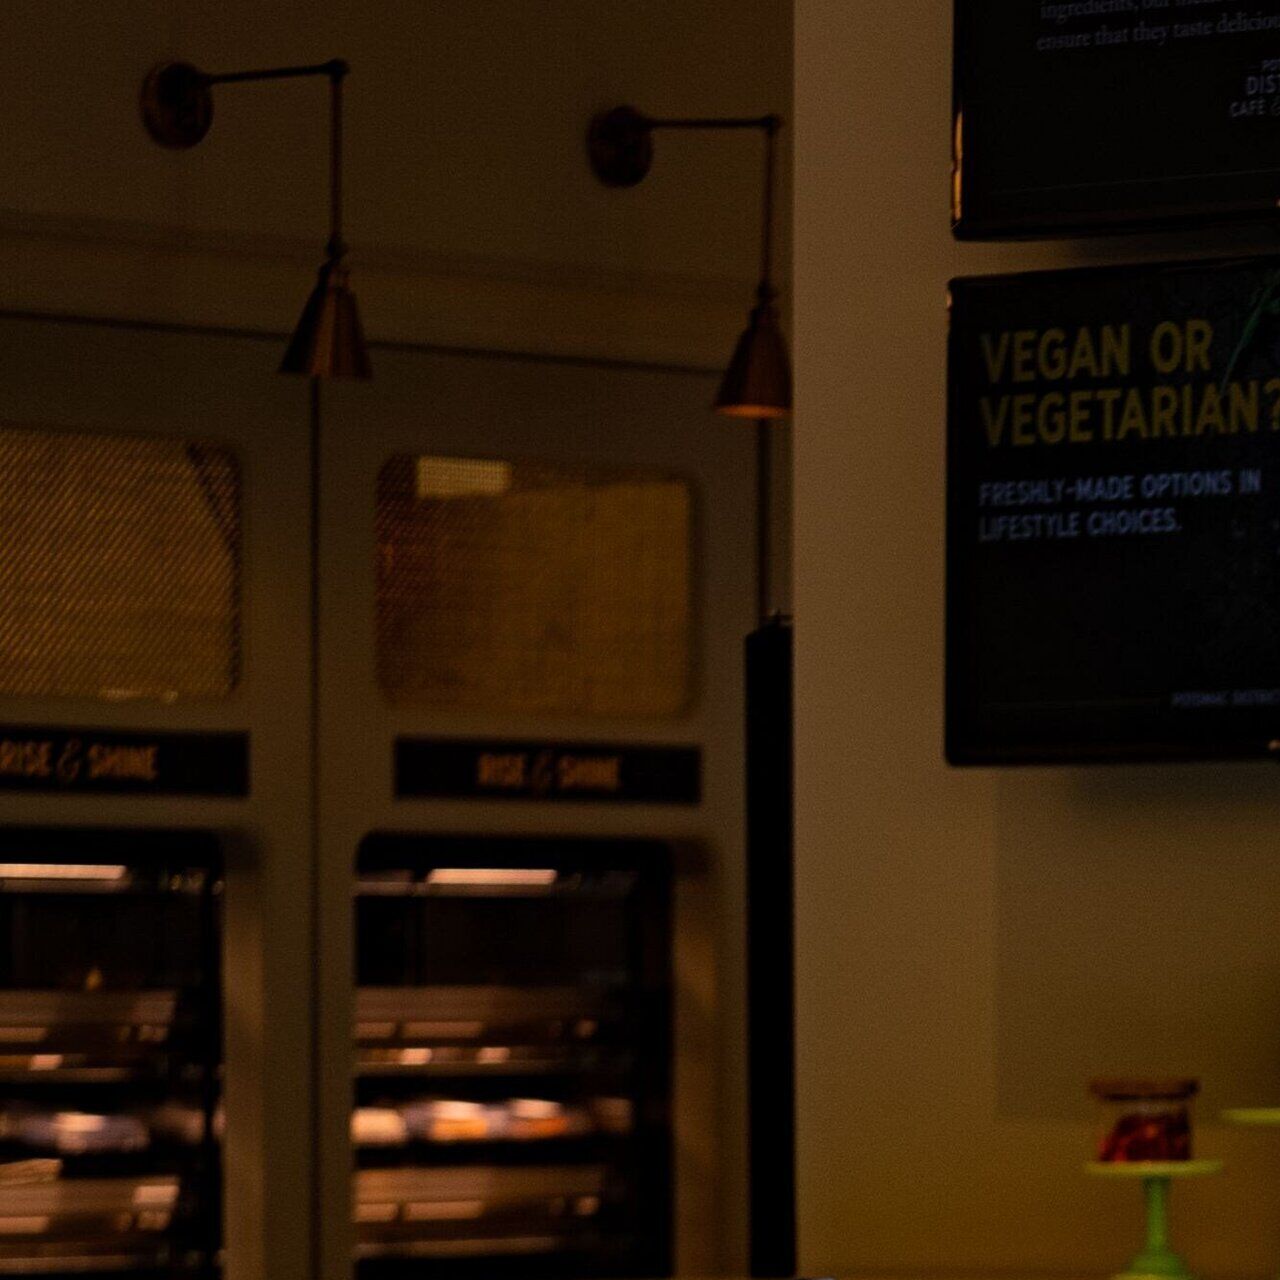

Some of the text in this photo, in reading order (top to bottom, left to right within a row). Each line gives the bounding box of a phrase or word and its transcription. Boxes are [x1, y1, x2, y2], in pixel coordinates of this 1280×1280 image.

[1095, 24, 1128, 46] that
[1133, 21, 1167, 46] they
[1173, 21, 1211, 40] taste
[980, 318, 1214, 384] VEGAN OR
[977, 468, 1263, 507] FRESHLY-MADE OPTIONS IN
[977, 506, 1184, 543] LIFESTYLE CHOICES.
[87, 743, 160, 781] SHINE
[477, 752, 526, 788] RISE
[558, 754, 621, 790] SHINE
